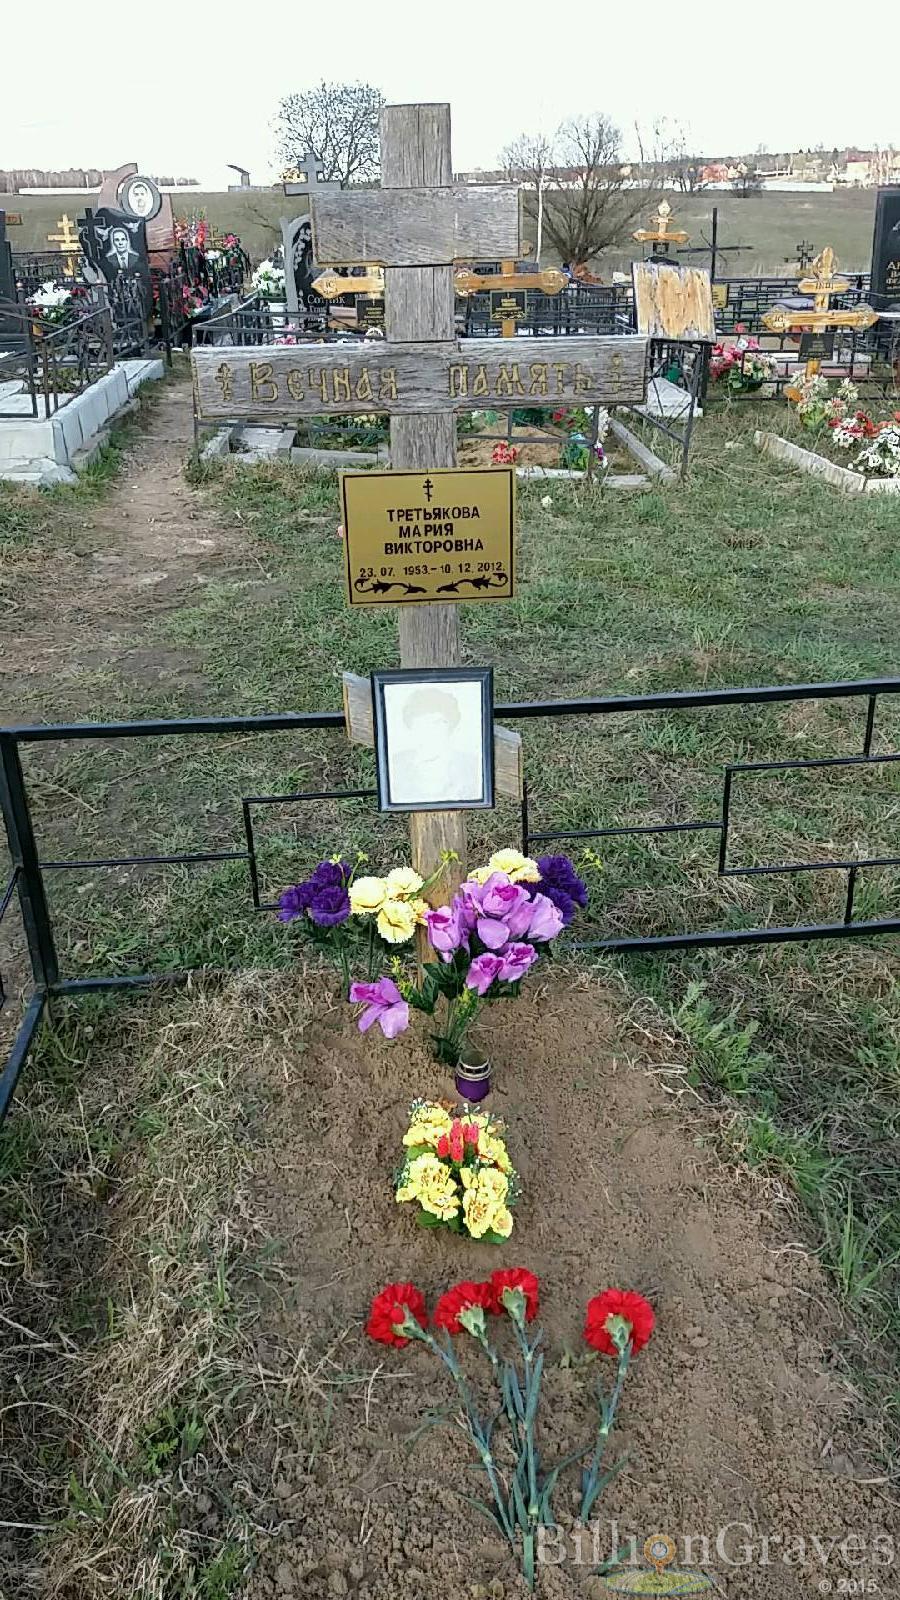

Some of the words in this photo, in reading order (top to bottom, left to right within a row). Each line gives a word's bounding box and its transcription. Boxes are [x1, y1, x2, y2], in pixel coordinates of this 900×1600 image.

[386, 506, 480, 522] ТРЕТЬЯКОВА
[399, 523, 454, 538] МАРИЯ
[384, 539, 484, 555] ВИКТОРОВНА
